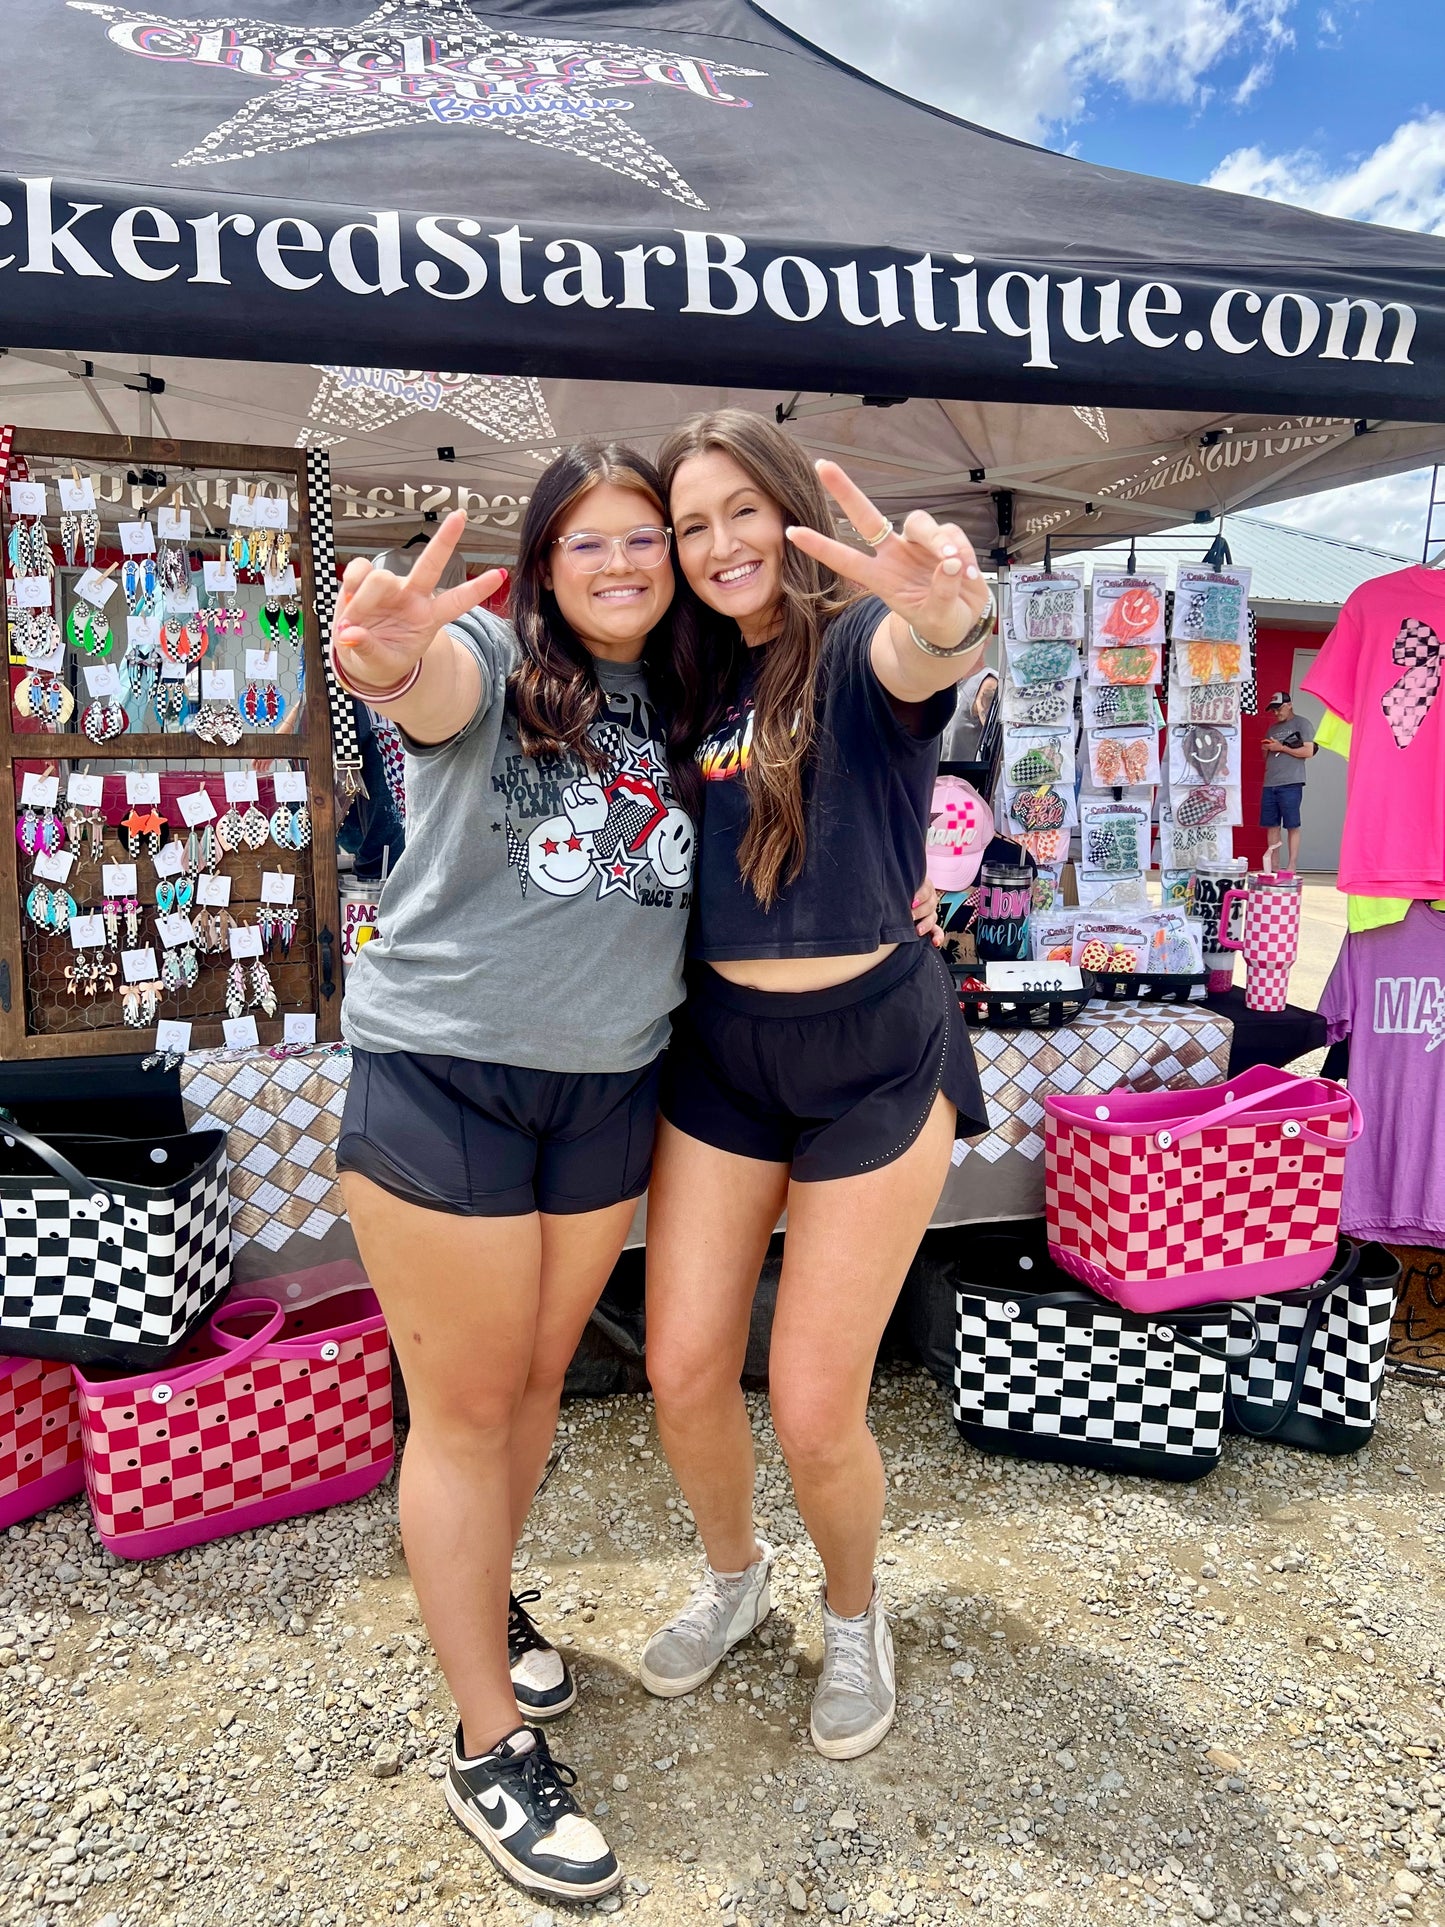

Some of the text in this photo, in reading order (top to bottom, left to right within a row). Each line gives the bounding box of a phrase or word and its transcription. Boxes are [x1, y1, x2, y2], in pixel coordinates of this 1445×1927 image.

[105, 21, 748, 106] Checkered
[299, 67, 555, 101] Star
[427, 95, 634, 123] Boutique
[1190, 697, 1233, 721] WIFE
[505, 755, 523, 772] IF
[492, 768, 529, 792] NOT
[518, 798, 561, 818] LAST
[1026, 805, 1063, 827] Hell
[639, 888, 674, 908] RACE
[346, 904, 378, 923] RAC
